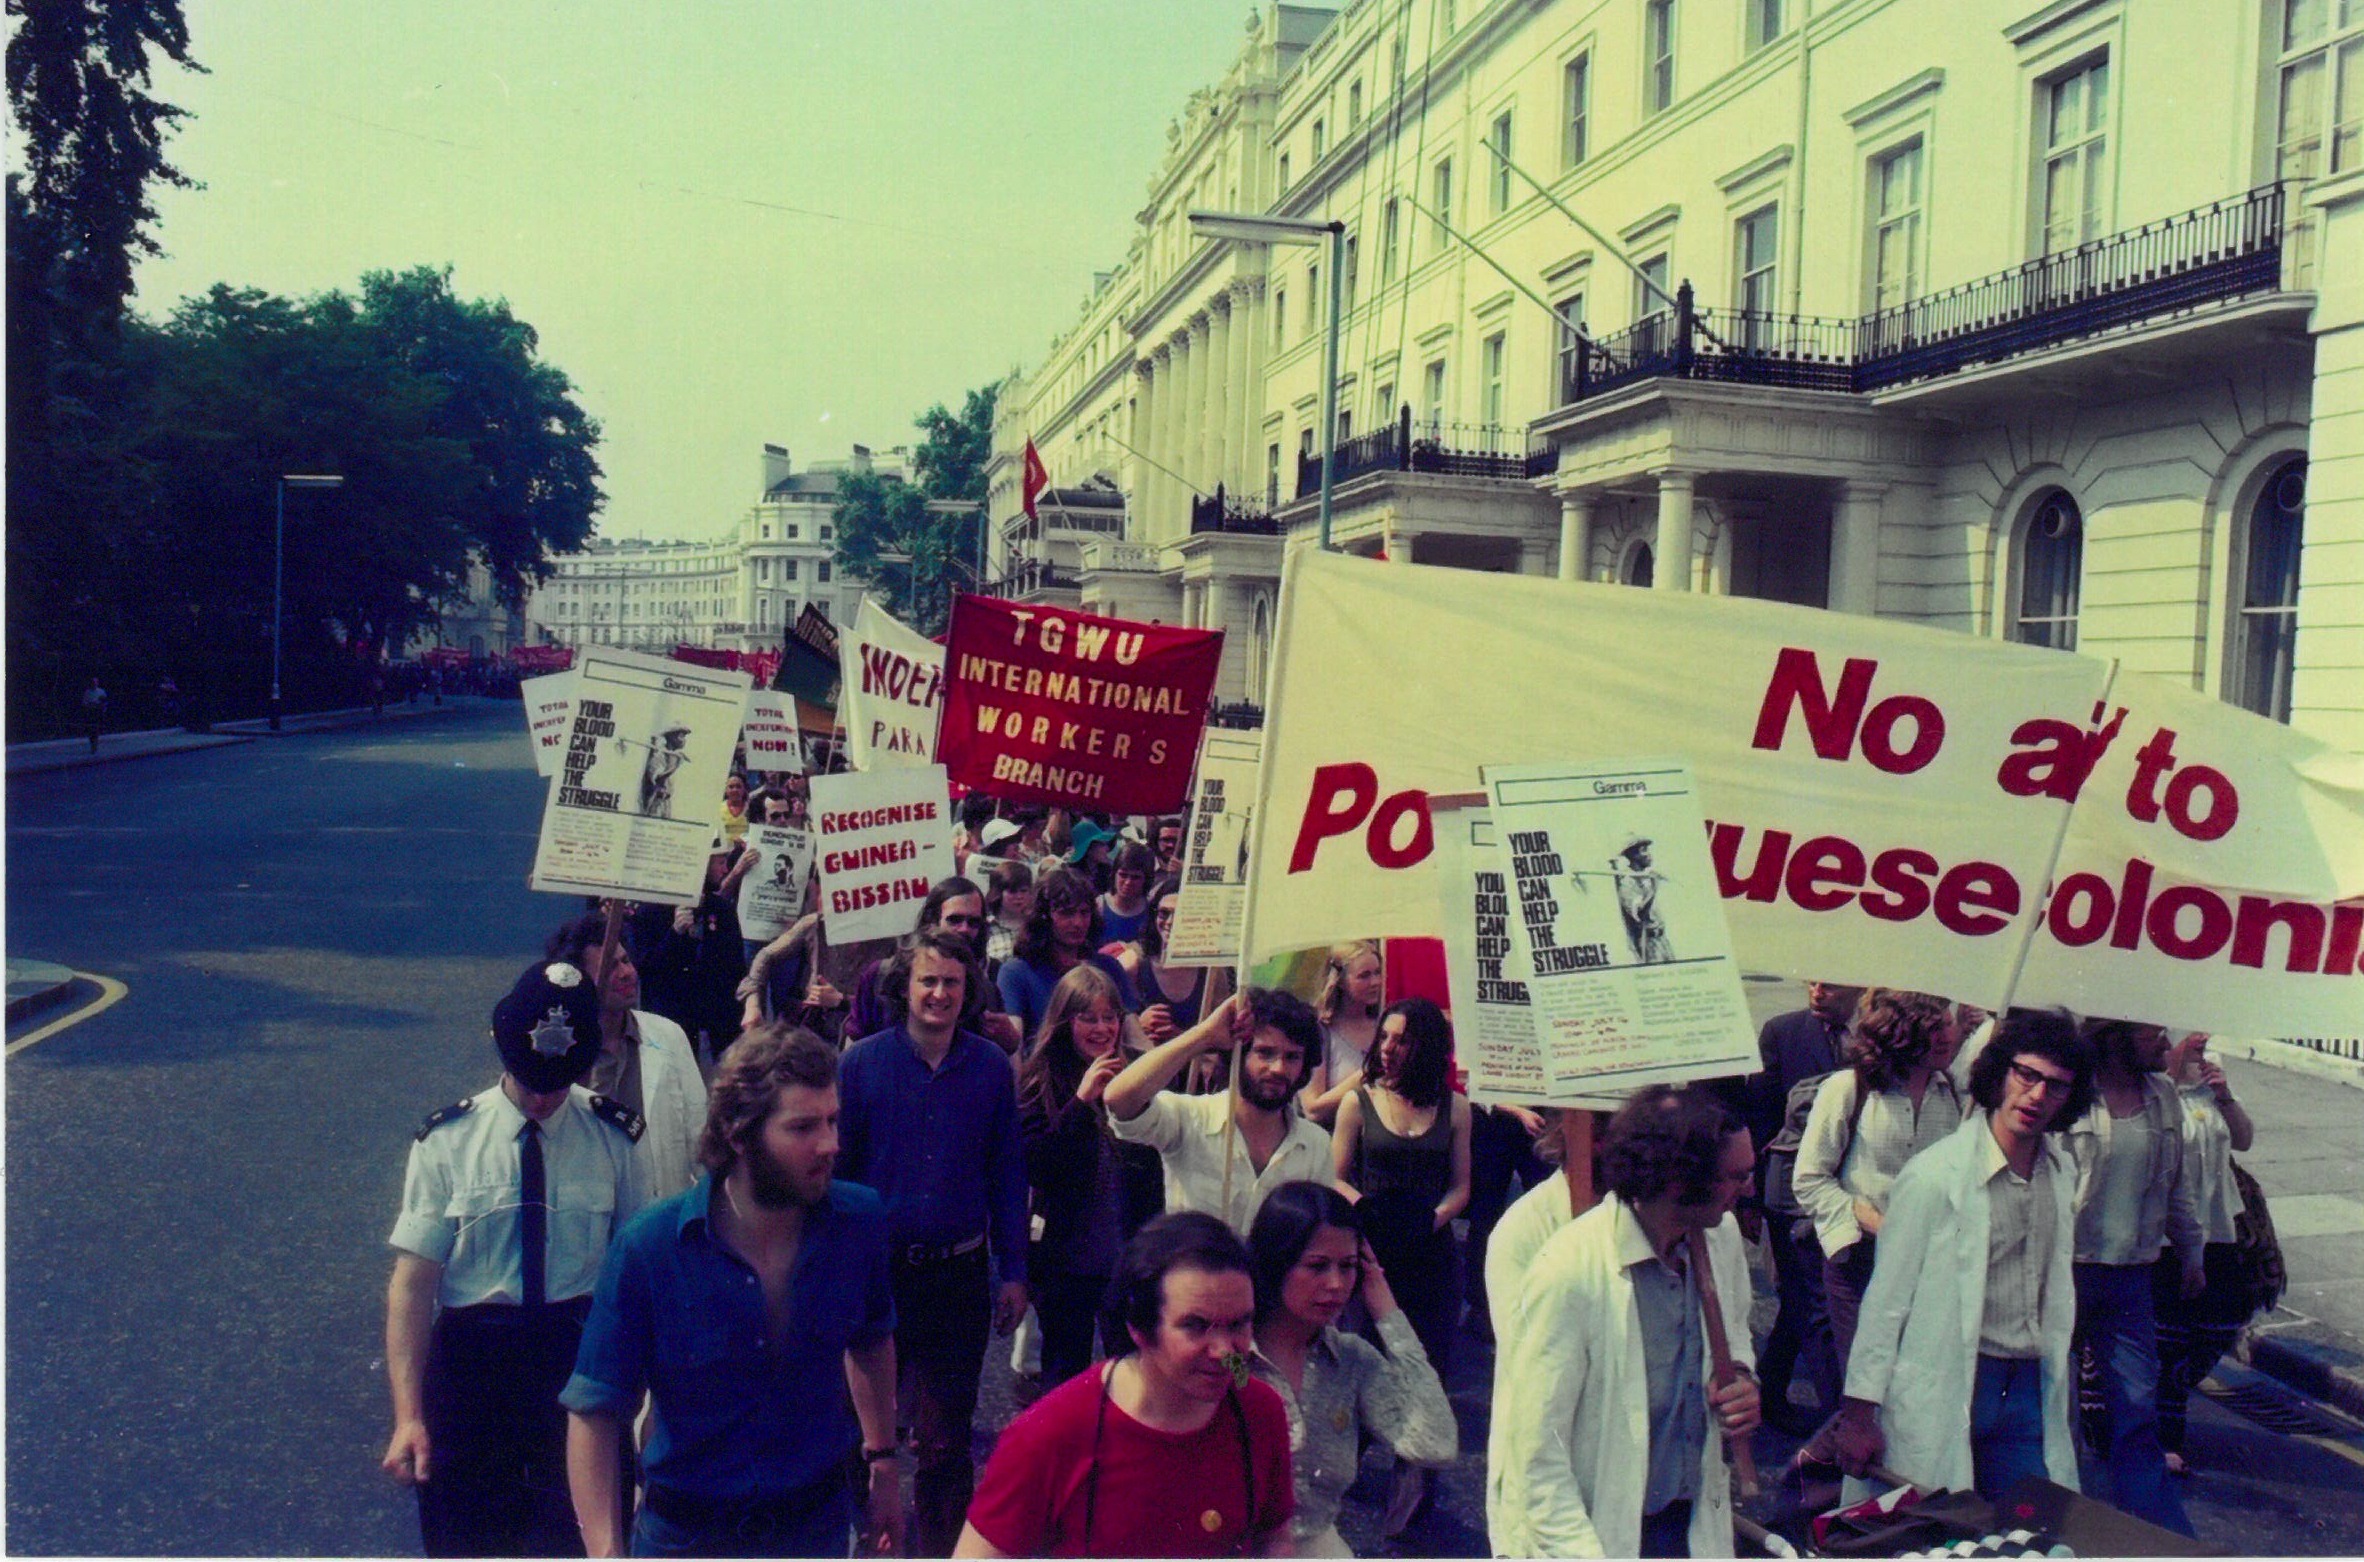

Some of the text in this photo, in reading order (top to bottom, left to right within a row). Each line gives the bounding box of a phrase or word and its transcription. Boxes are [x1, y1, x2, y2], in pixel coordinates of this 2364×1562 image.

[1011, 611, 1145, 665] TGWU
[959, 653, 1190, 715] INTERNATIONAL
[579, 699, 614, 720] YOUR
[573, 717, 616, 738] BLOOD
[872, 720, 926, 756] PARA
[569, 734, 597, 753] CAN
[1752, 647, 1946, 775] No
[2126, 727, 2239, 842] to
[565, 751, 597, 770] HELP
[562, 768, 586, 788] THE
[992, 753, 1104, 799] BRANCH
[558, 786, 622, 811] STRUGGLE
[821, 802, 937, 835] RECOGNISE
[1508, 830, 1551, 855] YOUR
[1512, 853, 1564, 878] BLOOD
[832, 876, 930, 914] BISSAU
[1517, 876, 1551, 902] CAN
[1521, 900, 1559, 925] HELP
[1476, 916, 1506, 936] CAN
[1526, 924, 1557, 949] THE
[1476, 937, 1511, 958] HELP
[1531, 943, 1611, 973] STRUGGLE
[1477, 958, 1502, 979] THE
